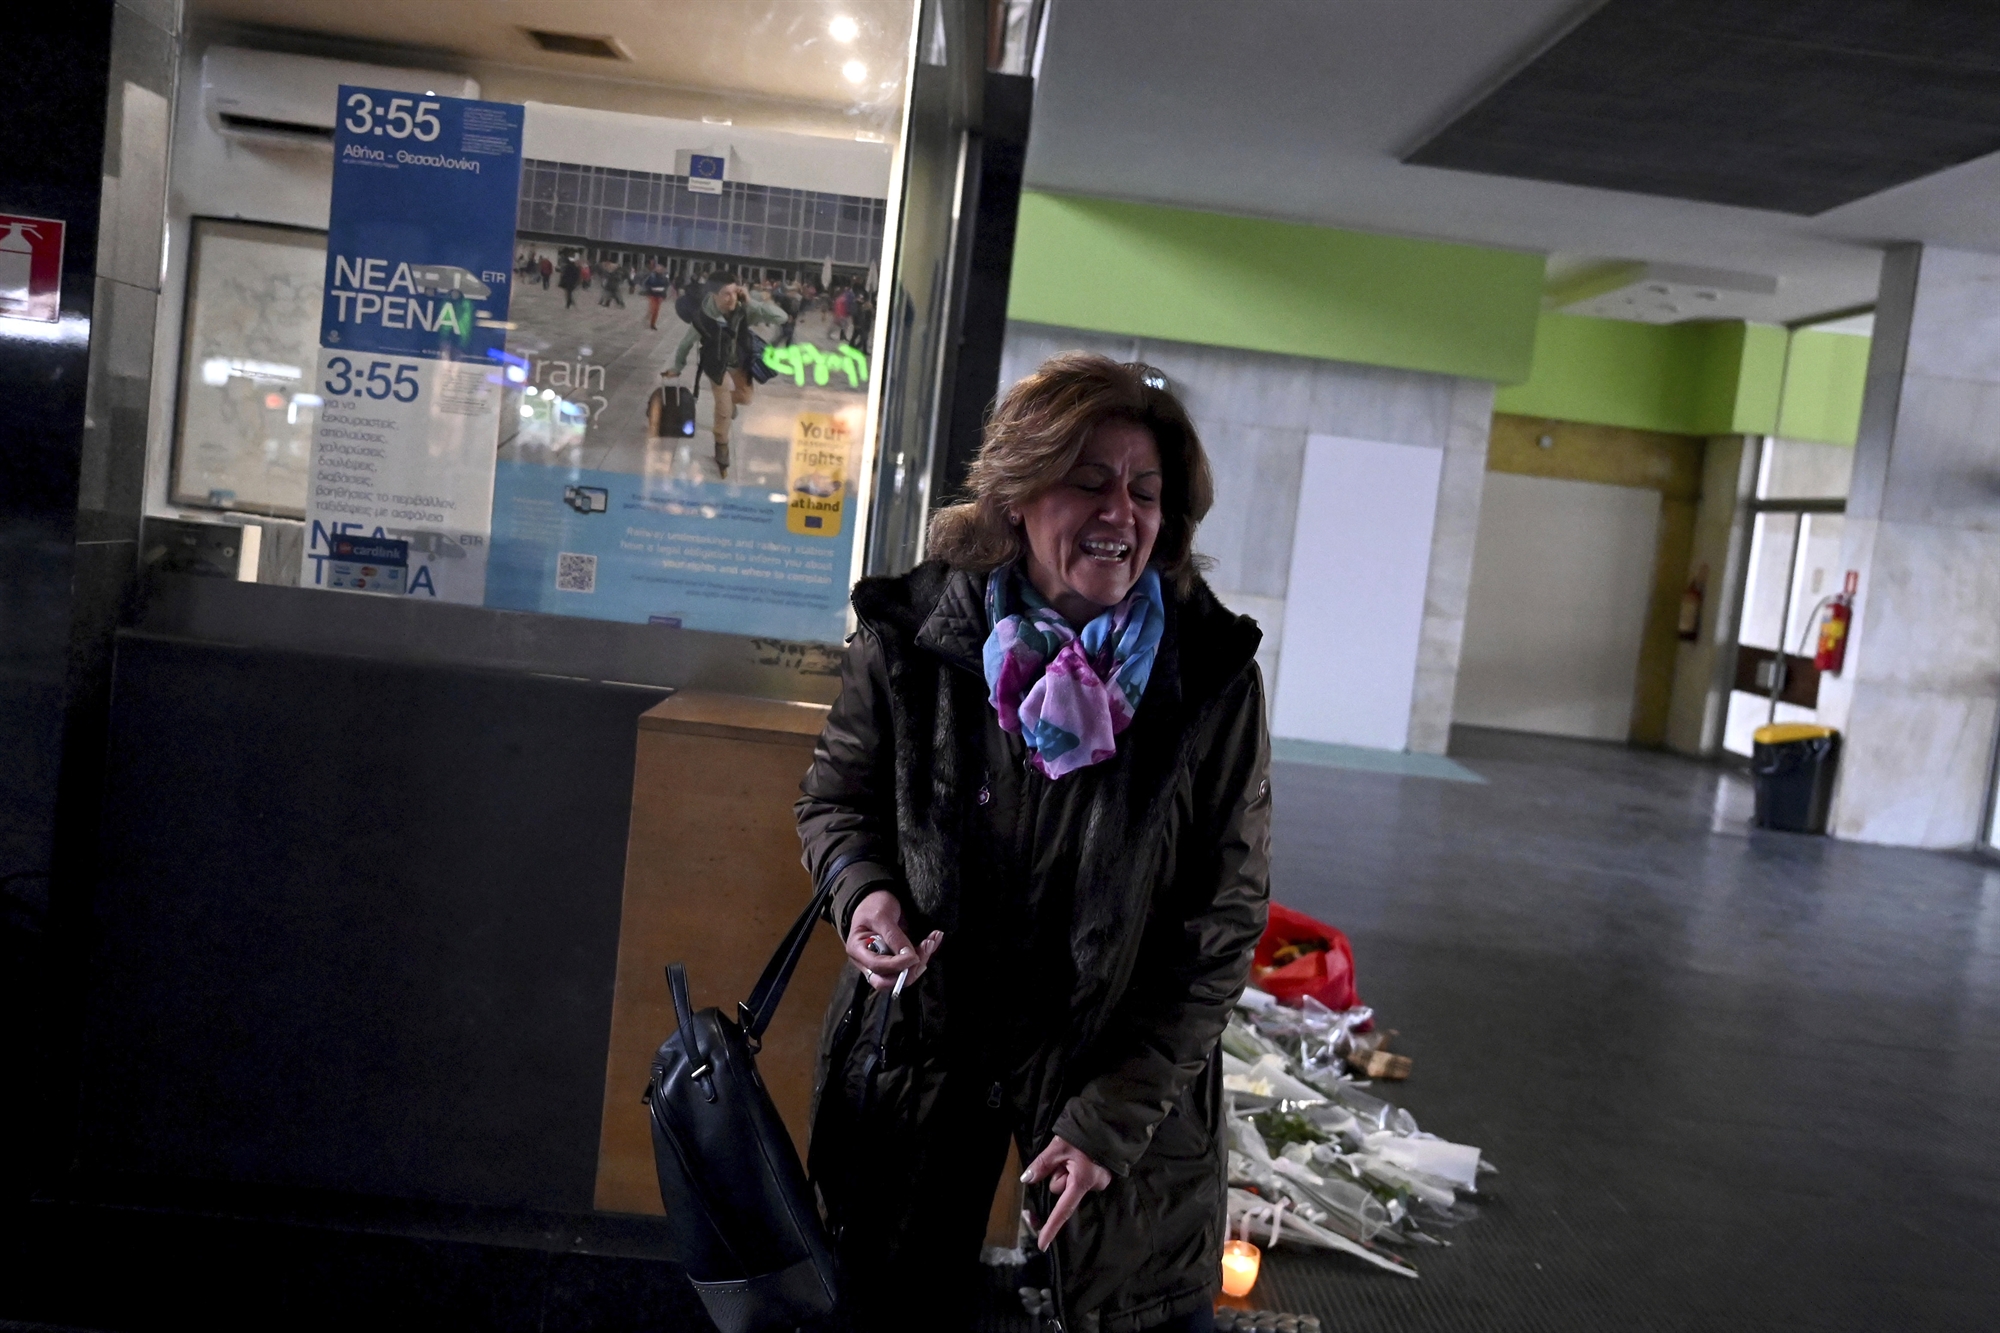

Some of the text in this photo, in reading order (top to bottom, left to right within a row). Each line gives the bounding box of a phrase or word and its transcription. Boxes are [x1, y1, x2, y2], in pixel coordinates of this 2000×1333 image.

[345, 93, 441, 142] 3:55
[343, 144, 384, 161] Αθήνα
[396, 150, 480, 174] Θεσσαλονίκη
[333, 255, 417, 295] ΝΕΑ
[482, 271, 506, 283] ETR
[331, 290, 461, 335] ΤΡΕΝΑ
[325, 357, 419, 403] 3:55
[516, 349, 605, 391] Train
[801, 421, 844, 441] Your
[796, 449, 844, 467] rights
[377, 493, 389, 502] το
[791, 498, 840, 512] at hand
[460, 535, 483, 546] ETR
[353, 546, 401, 559] cardlink
